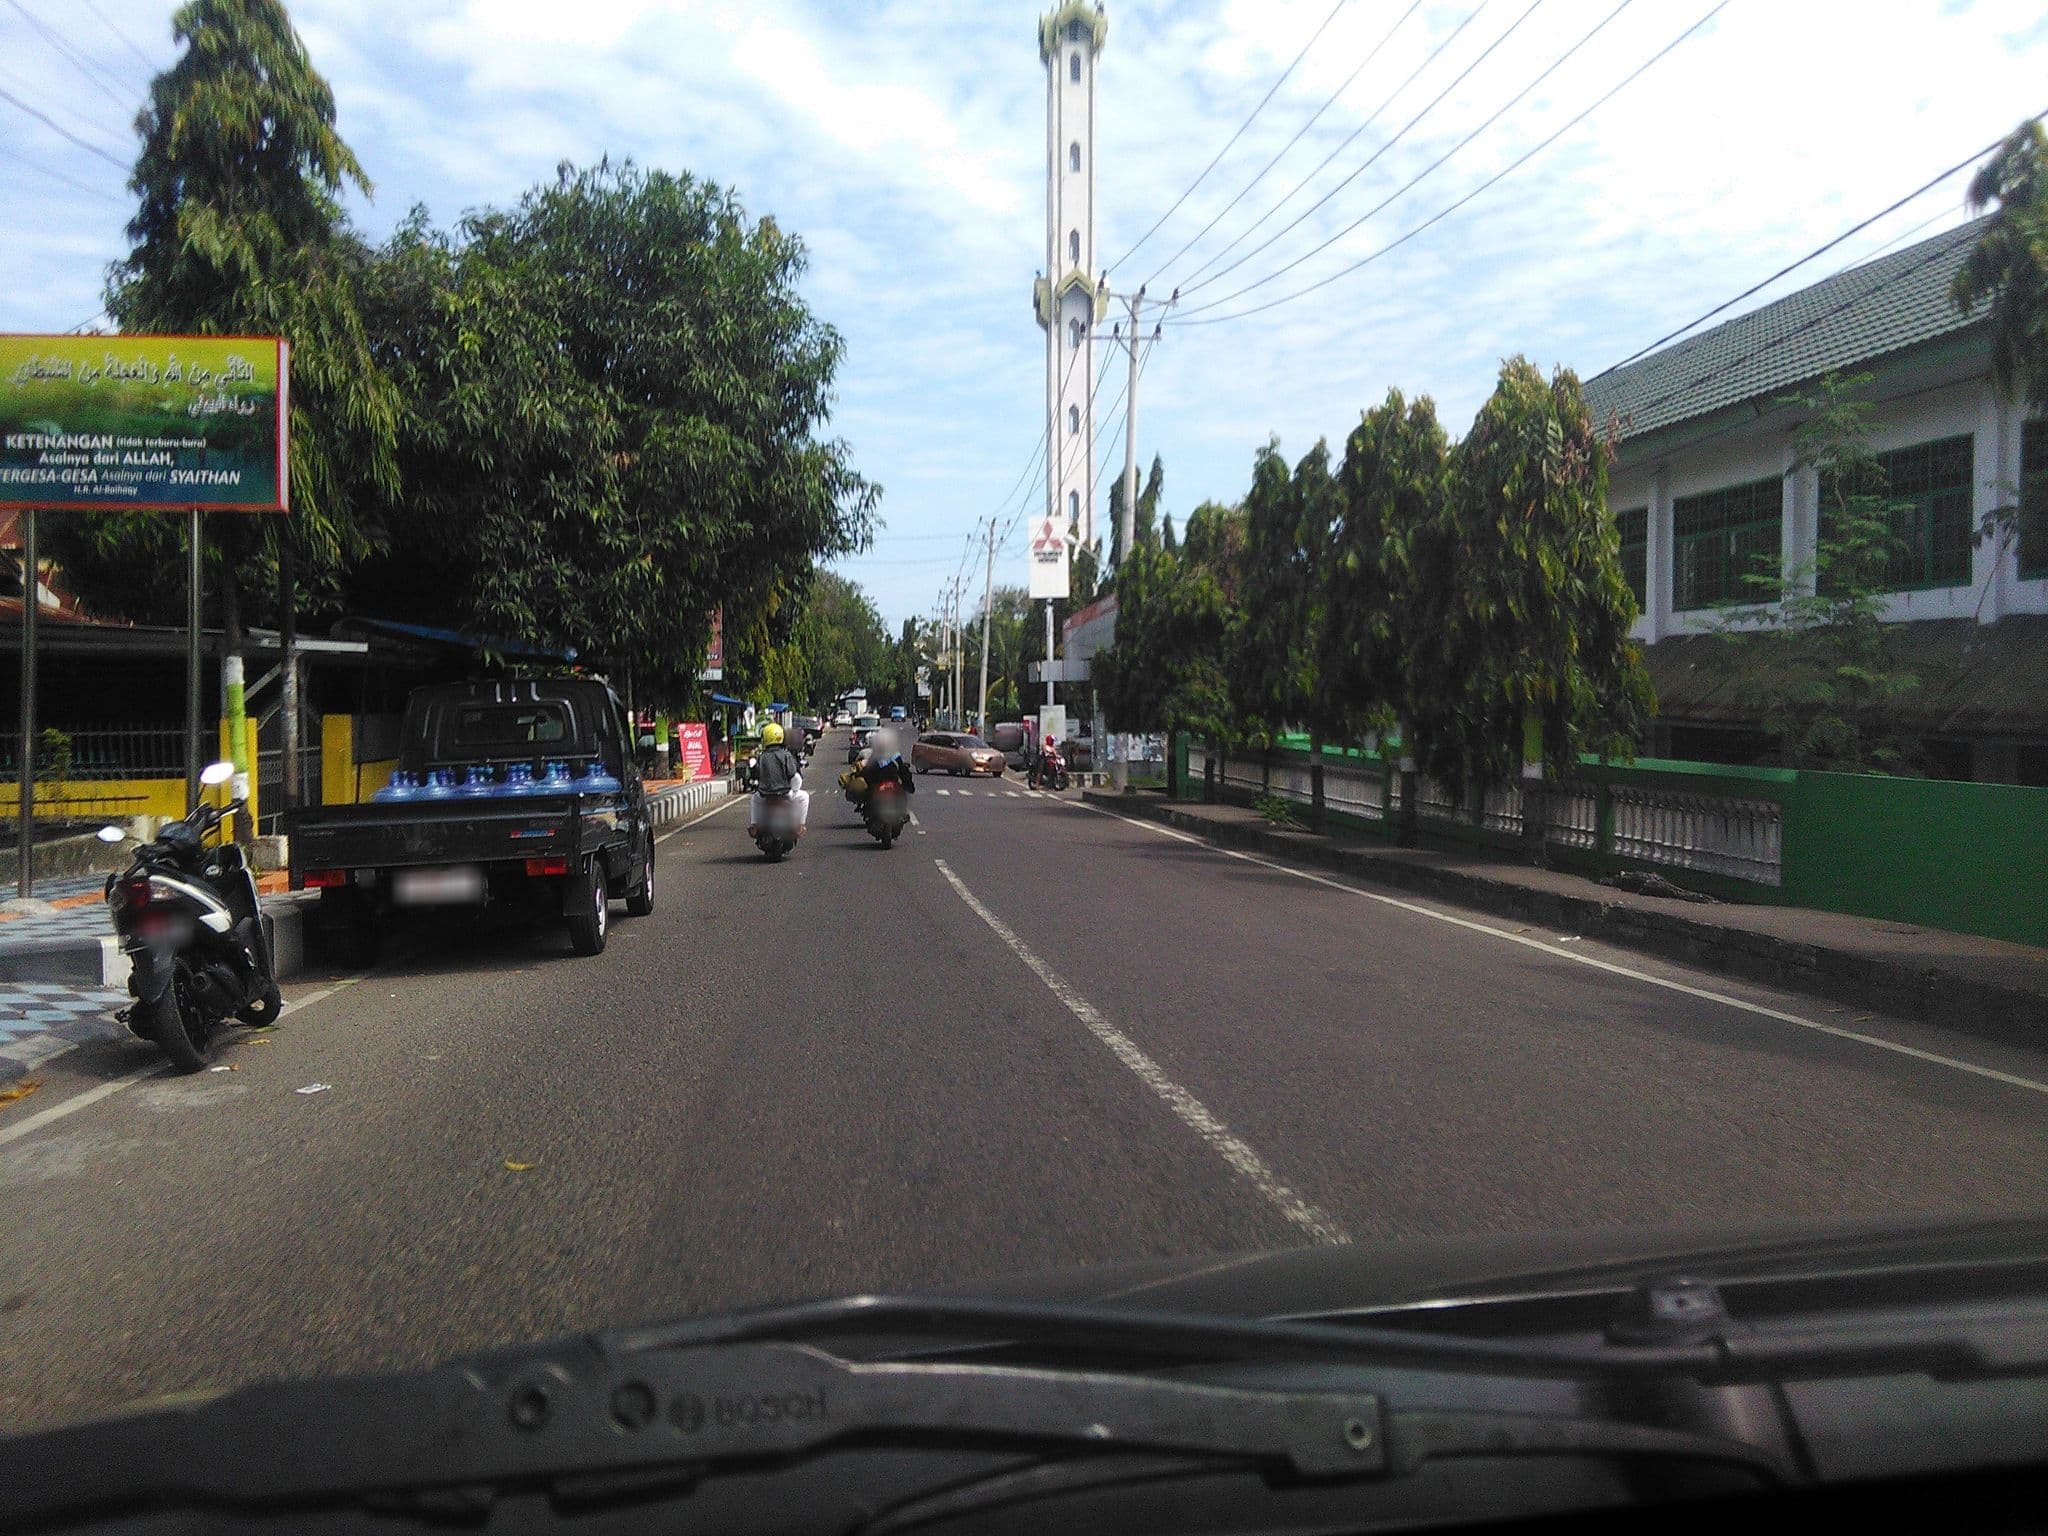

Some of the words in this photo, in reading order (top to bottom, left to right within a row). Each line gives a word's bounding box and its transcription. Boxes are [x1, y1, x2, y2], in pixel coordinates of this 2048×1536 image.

[6, 433, 113, 449] KETENANGAN
[116, 436, 143, 448] (tidak
[145, 436, 207, 448] terburu-buru)
[39, 451, 89, 467] Asalnya
[93, 451, 119, 465] dari
[123, 451, 174, 467] ALLAH,
[101, 468, 143, 484] Asalnya
[145, 468, 167, 482] dari
[169, 469, 241, 485] SYAITHAN
[713, 1386, 828, 1424] BOSCH
